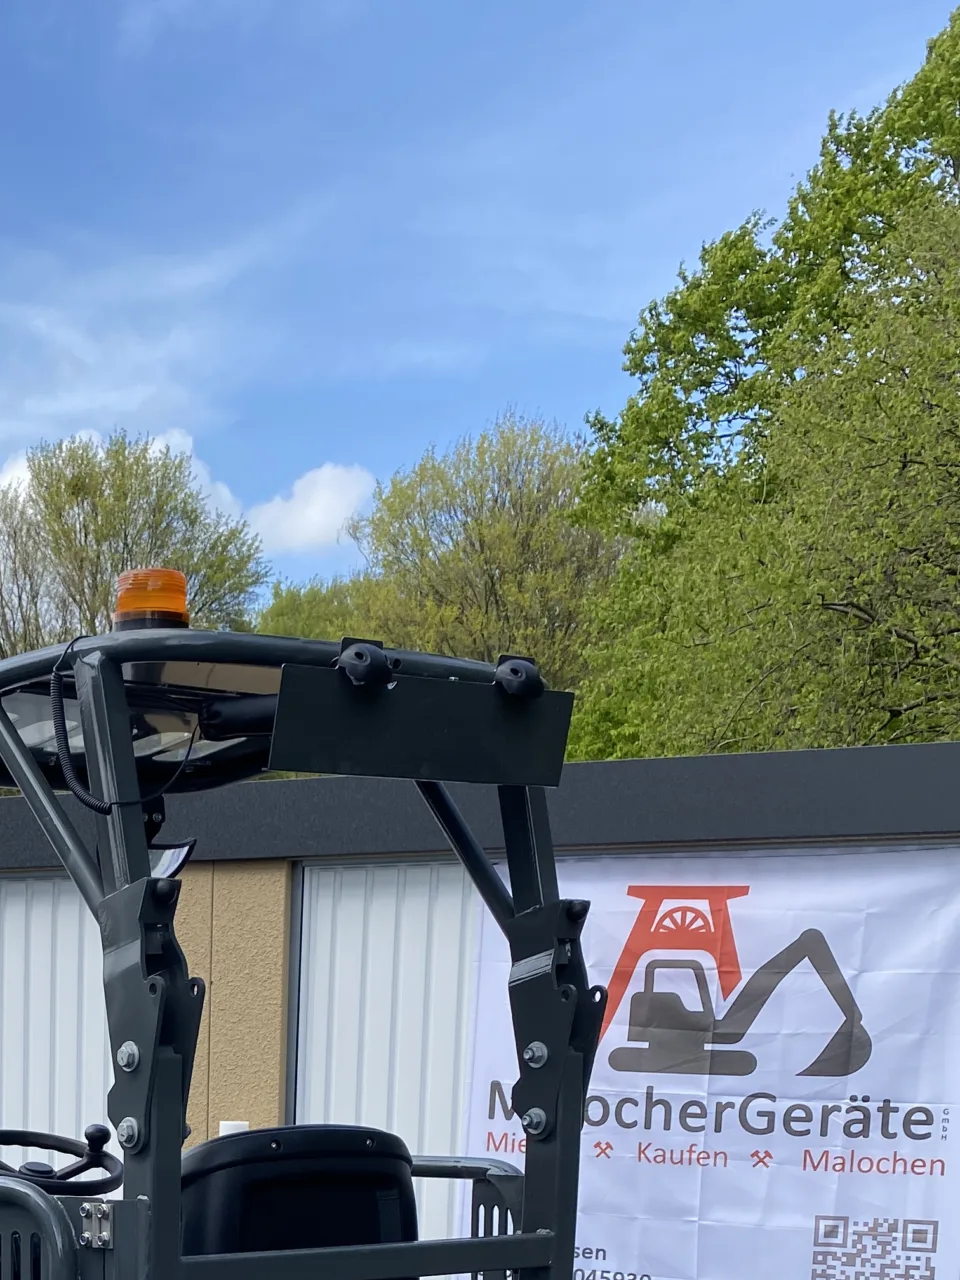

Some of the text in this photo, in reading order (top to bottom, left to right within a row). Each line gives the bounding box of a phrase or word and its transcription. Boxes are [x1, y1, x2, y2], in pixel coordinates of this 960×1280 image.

[487, 1079, 935, 1141] MocherGeräte
[637, 1141, 728, 1168] Kaufen
[802, 1149, 946, 1177] Malochen
[574, 1246, 607, 1261] sen
